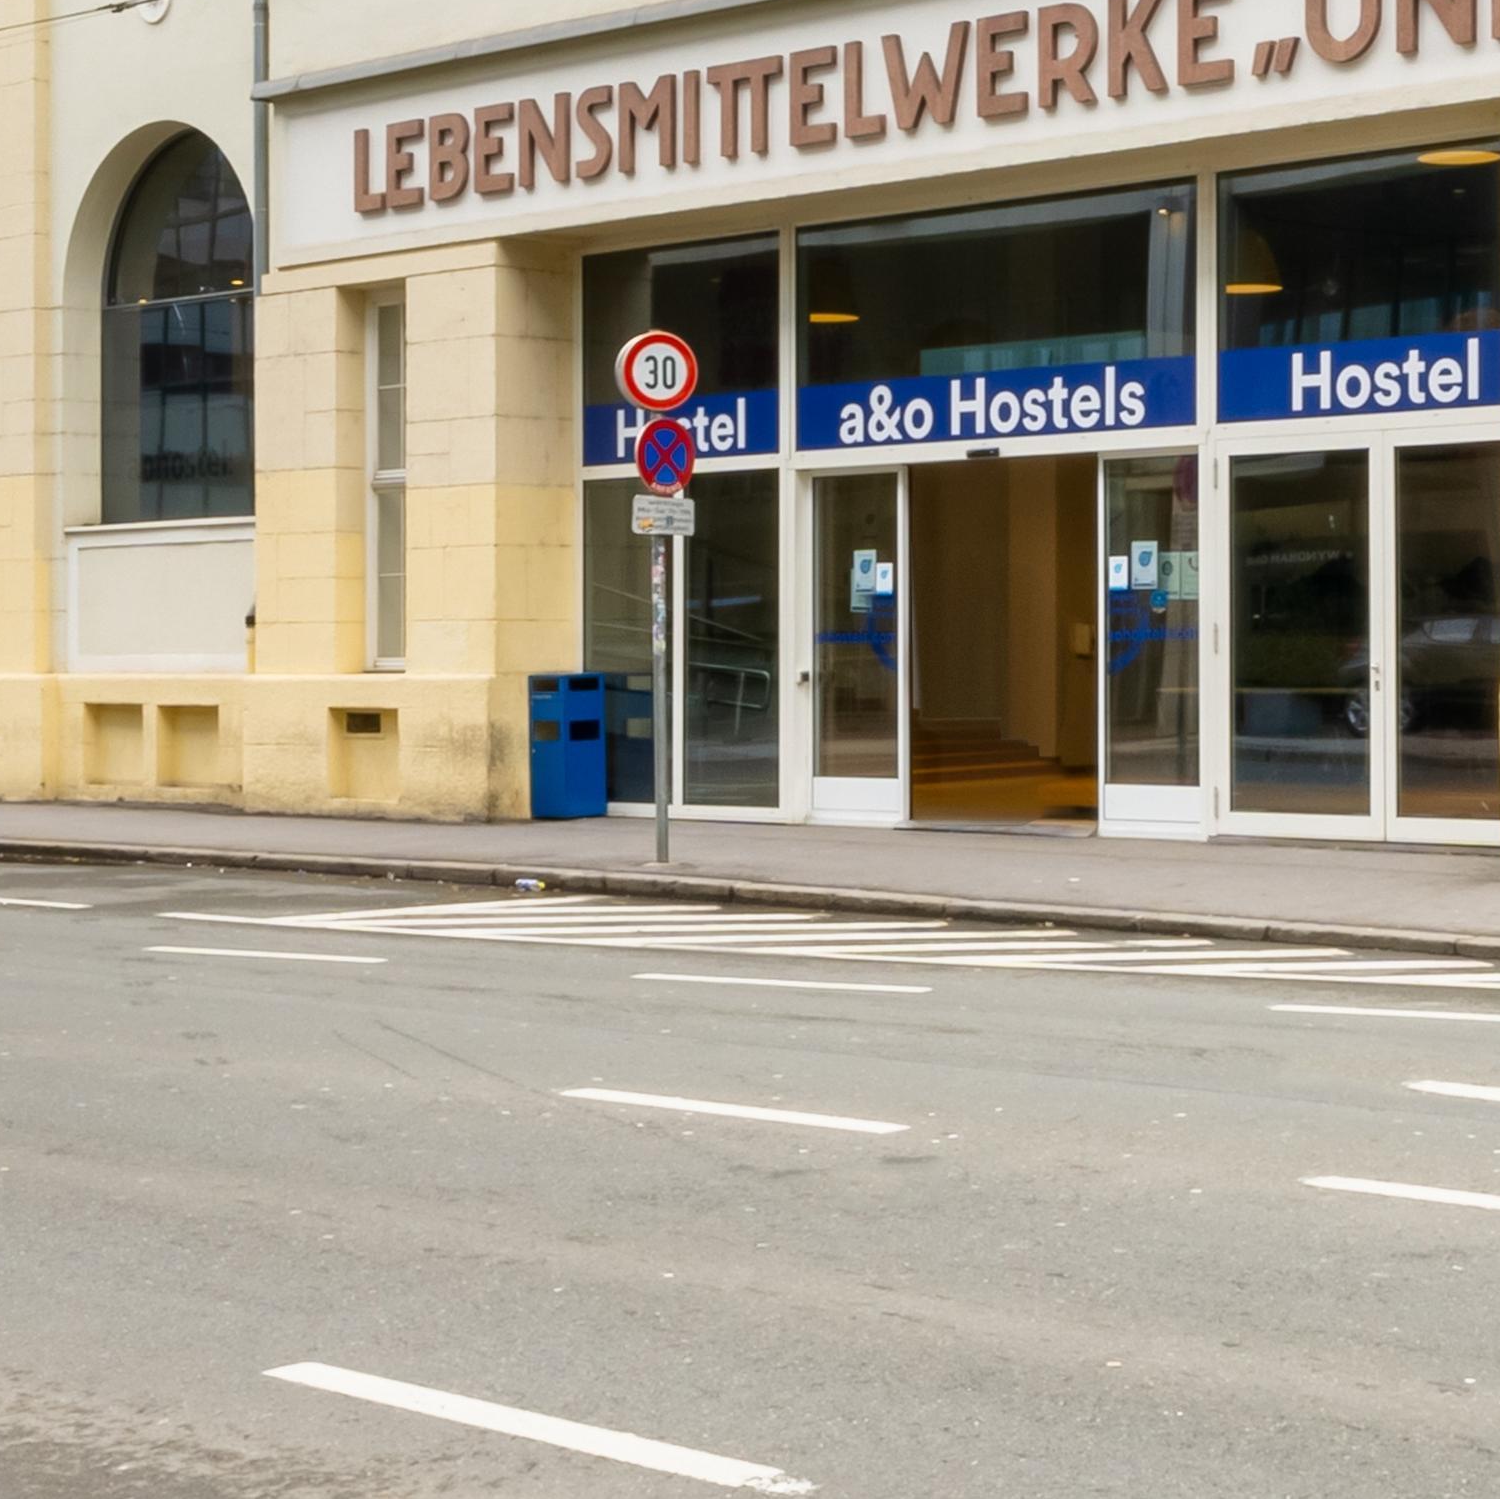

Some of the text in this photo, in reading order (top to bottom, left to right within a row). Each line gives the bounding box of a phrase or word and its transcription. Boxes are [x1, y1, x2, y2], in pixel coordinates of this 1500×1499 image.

[643, 355, 677, 390] 30
[838, 365, 1147, 446] a&o Hostels
[1290, 337, 1482, 412] Hostel
[616, 397, 747, 459] Htel
